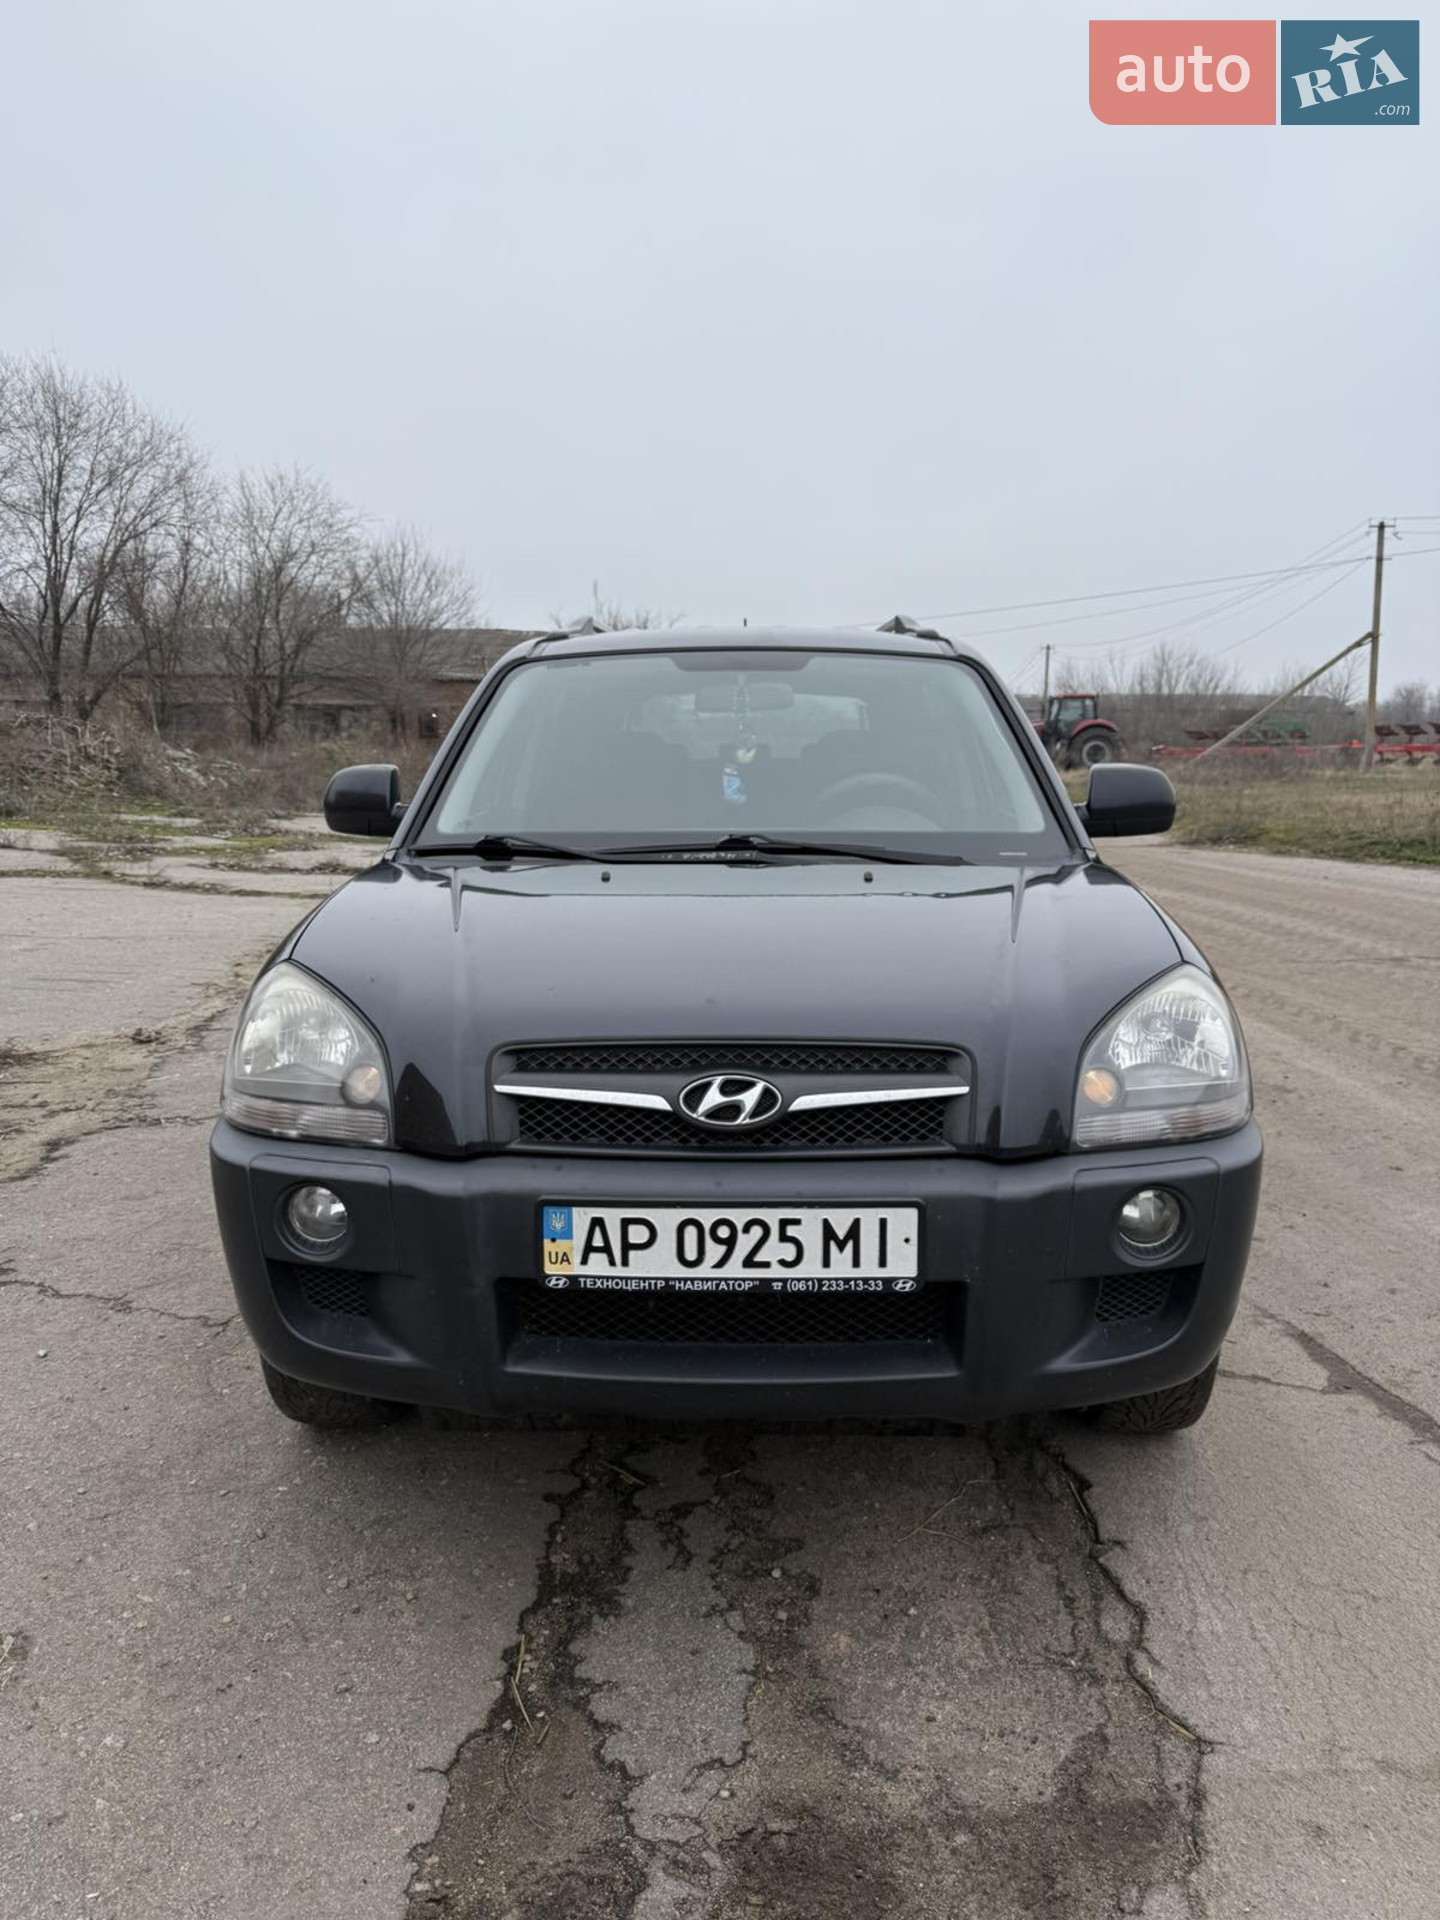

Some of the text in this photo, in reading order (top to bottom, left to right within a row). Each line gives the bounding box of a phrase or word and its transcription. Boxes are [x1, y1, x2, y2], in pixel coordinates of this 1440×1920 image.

[580, 1217, 888, 1269] AP 0925 MI
[548, 1251, 571, 1265] UA
[578, 1277, 665, 1291] ТЕХНОЦЕНТР
[786, 1279, 818, 1292] (061)
[821, 1280, 884, 1291] 233-13-33
